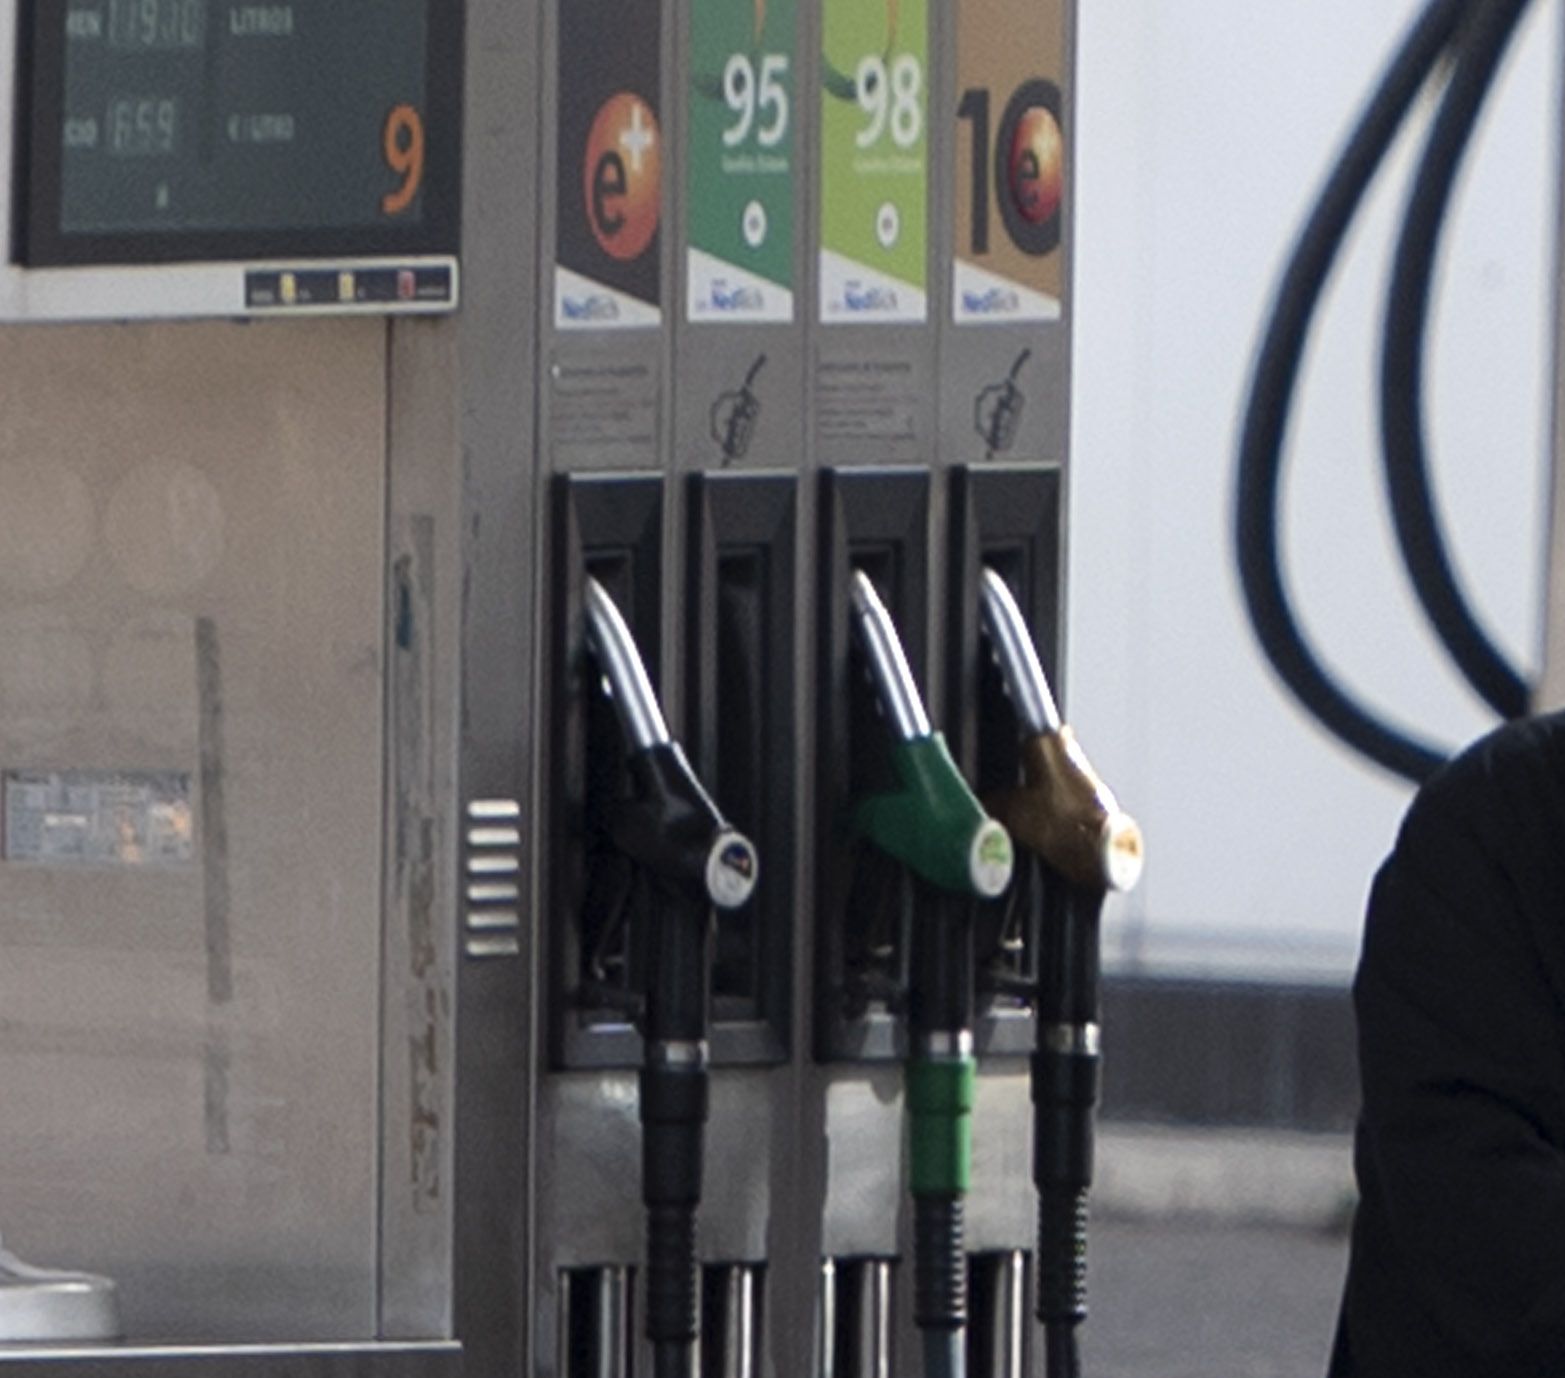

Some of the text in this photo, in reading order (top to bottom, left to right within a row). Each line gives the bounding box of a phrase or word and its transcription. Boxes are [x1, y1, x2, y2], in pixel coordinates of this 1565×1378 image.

[722, 54, 790, 147] 95
[855, 54, 924, 148] 98
[382, 104, 425, 214] 9
[956, 78, 1064, 256] 10
